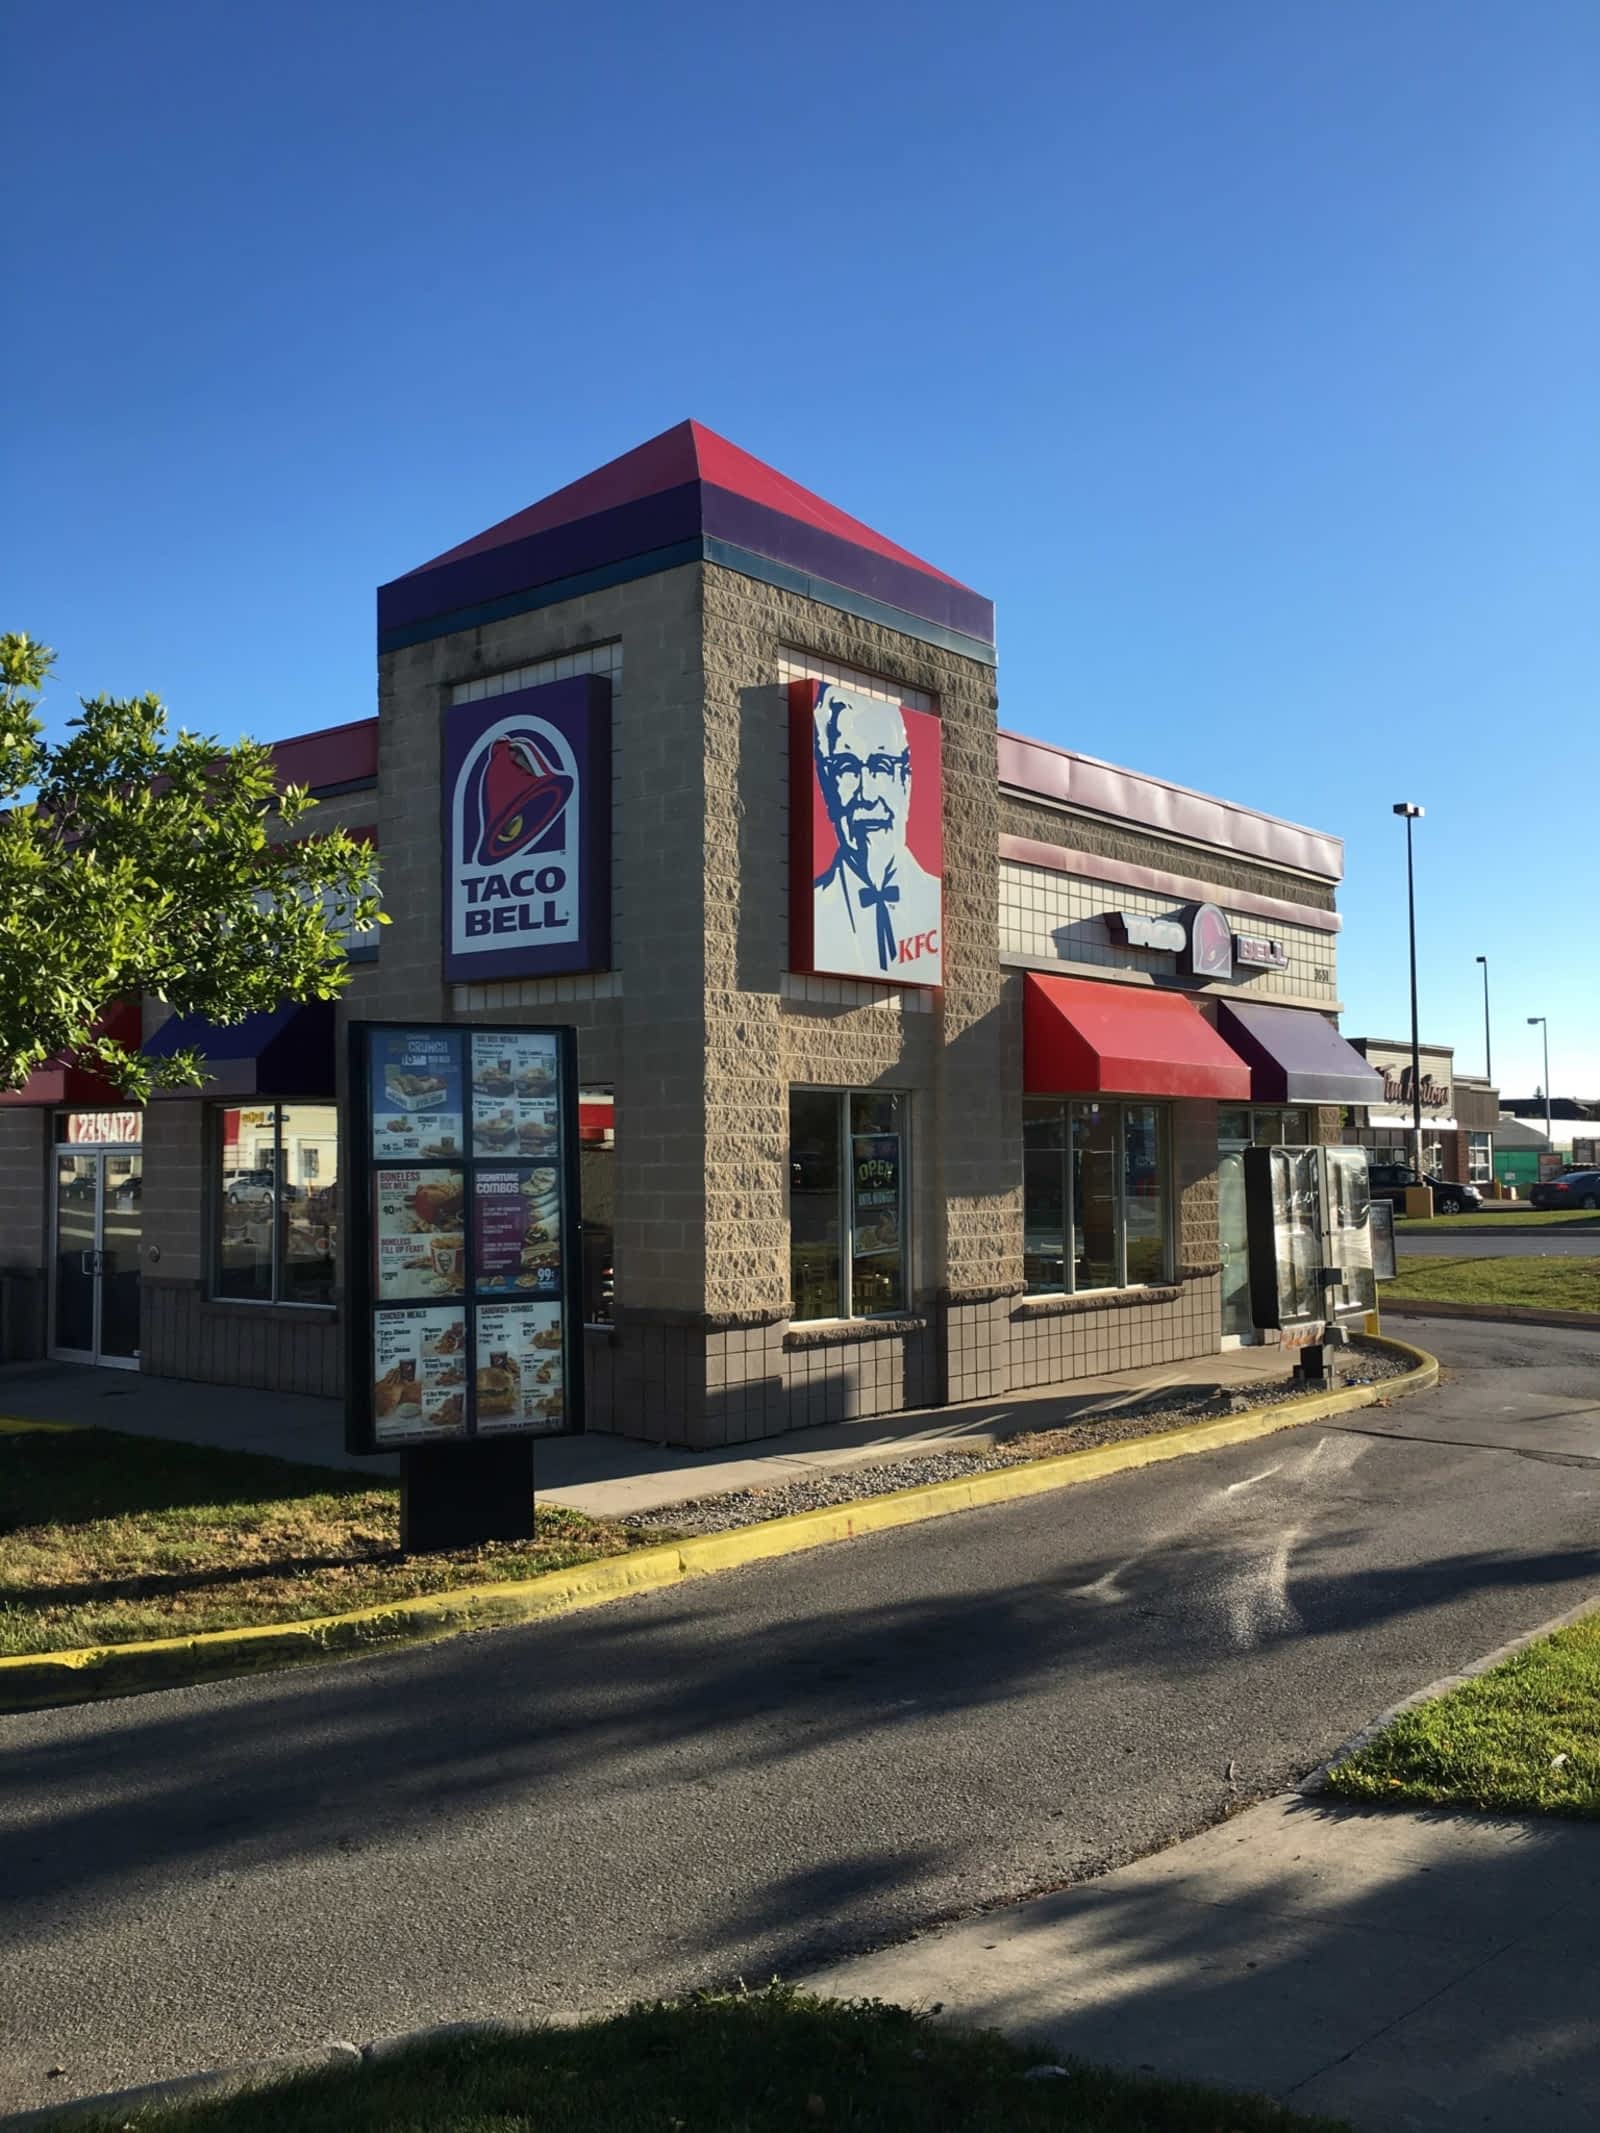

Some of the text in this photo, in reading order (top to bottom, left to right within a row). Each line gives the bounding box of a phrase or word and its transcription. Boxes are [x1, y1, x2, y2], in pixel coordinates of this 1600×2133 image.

[461, 866, 566, 904] TACO
[465, 901, 569, 937] BELL
[898, 928, 938, 964] KFC
[1239, 937, 1289, 970] BELL
[858, 1160, 894, 1181] OPEN
[476, 1182, 520, 1194] COMBOS
